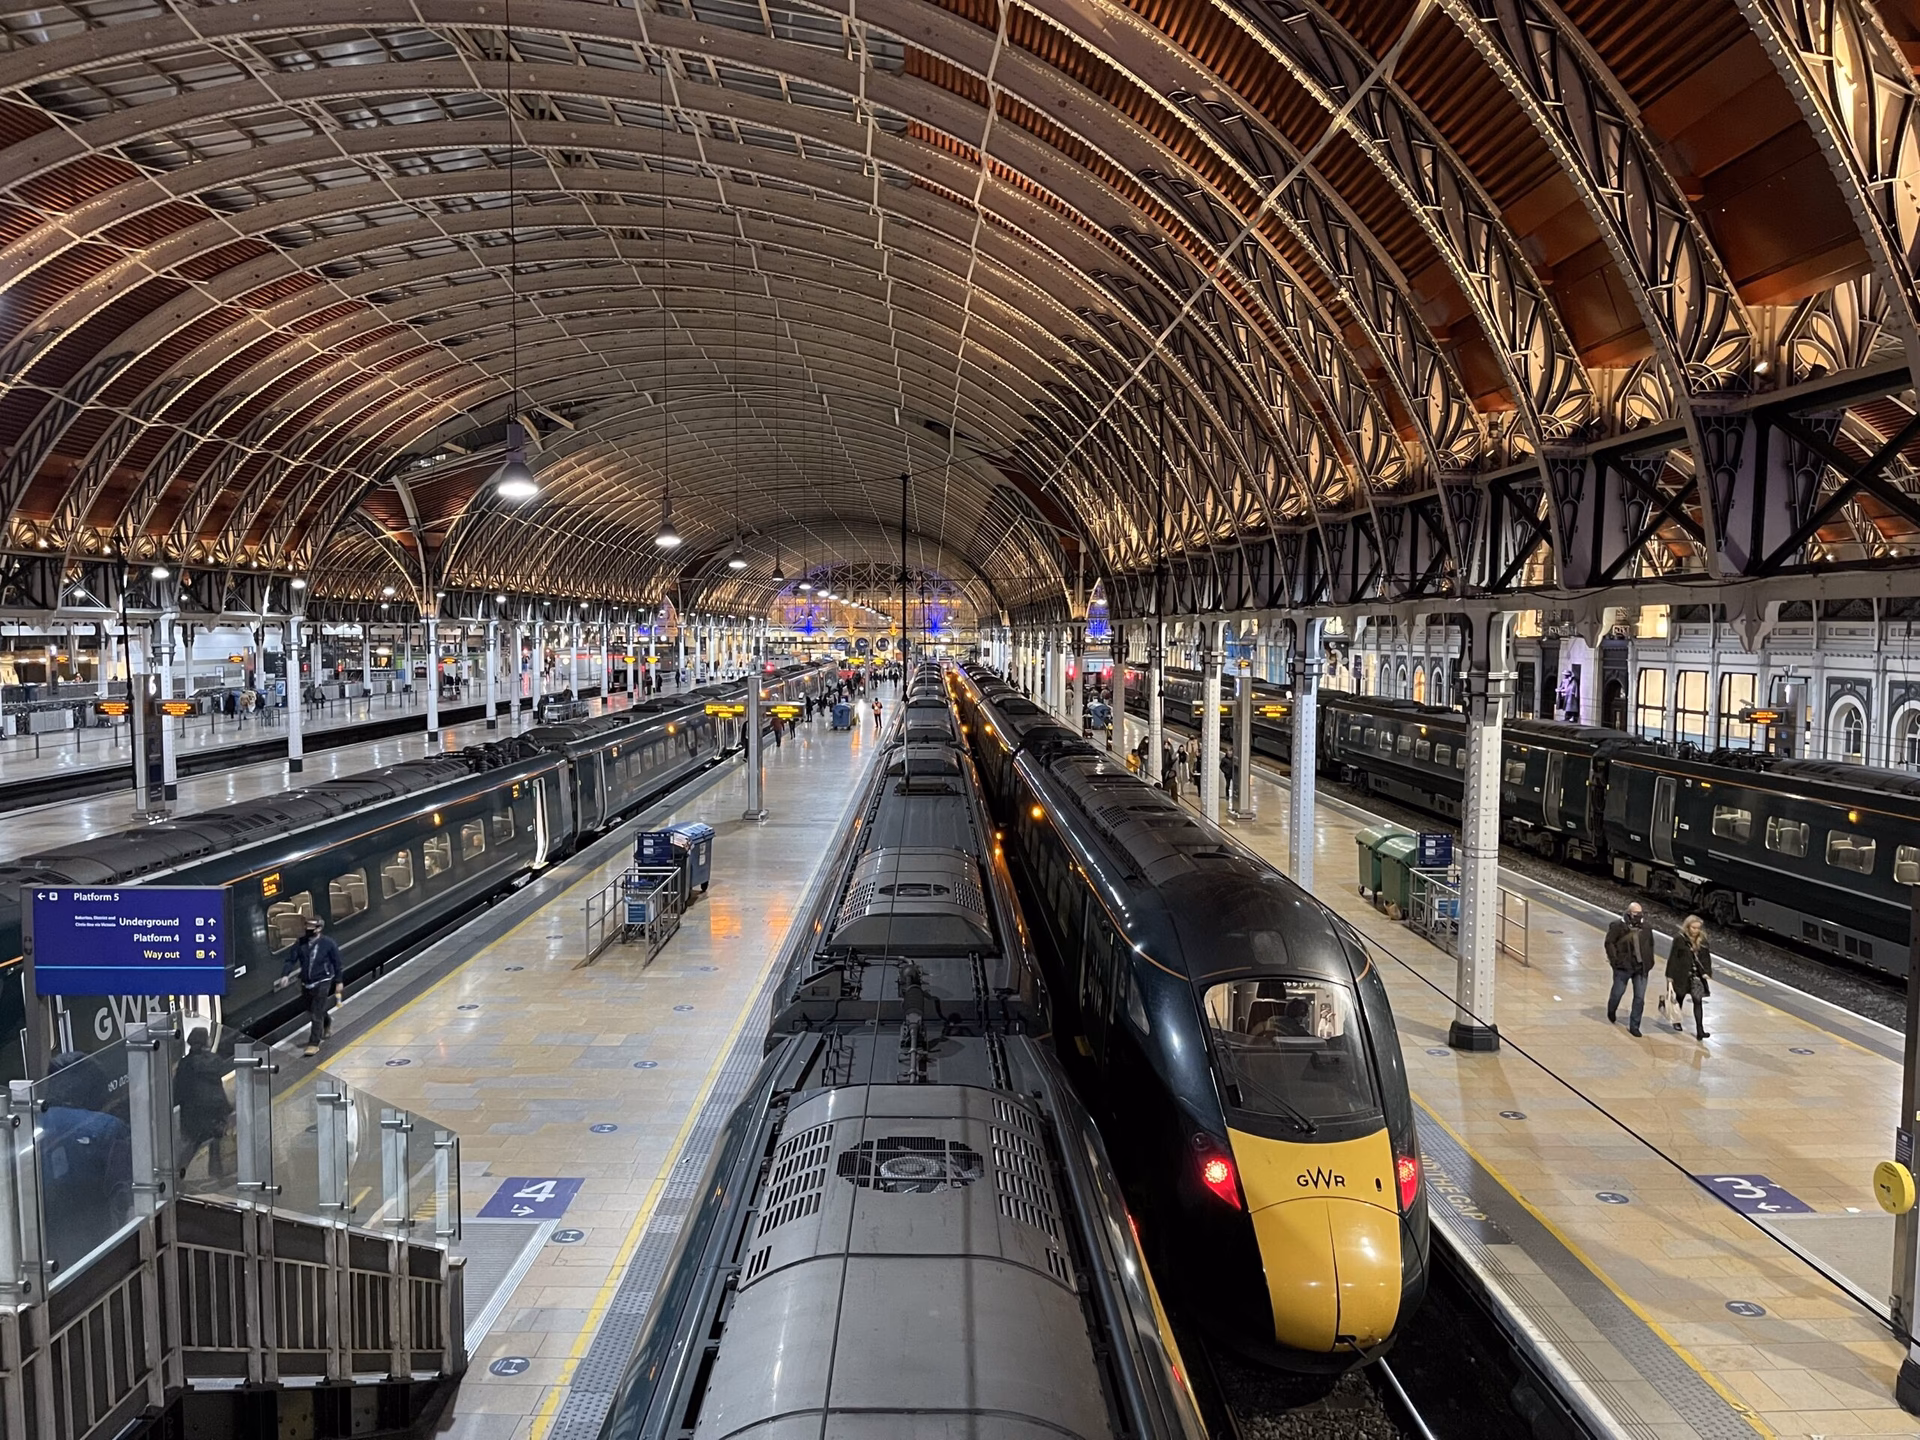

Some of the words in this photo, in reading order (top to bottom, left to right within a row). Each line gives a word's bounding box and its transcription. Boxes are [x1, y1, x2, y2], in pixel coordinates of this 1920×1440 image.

[149, 675, 156, 695] 6
[73, 892, 111, 901] Platform
[113, 892, 120, 901] 5
[119, 917, 180, 928] Underground
[133, 933, 172, 942] Platform
[173, 933, 180, 942] 4
[143, 950, 163, 960] Way
[164, 950, 181, 960] out
[1296, 1166, 1346, 1189] GWR
[1713, 1177, 1767, 1198] 3
[512, 1180, 557, 1202] 4
[1446, 1195, 1487, 1221] GAP
